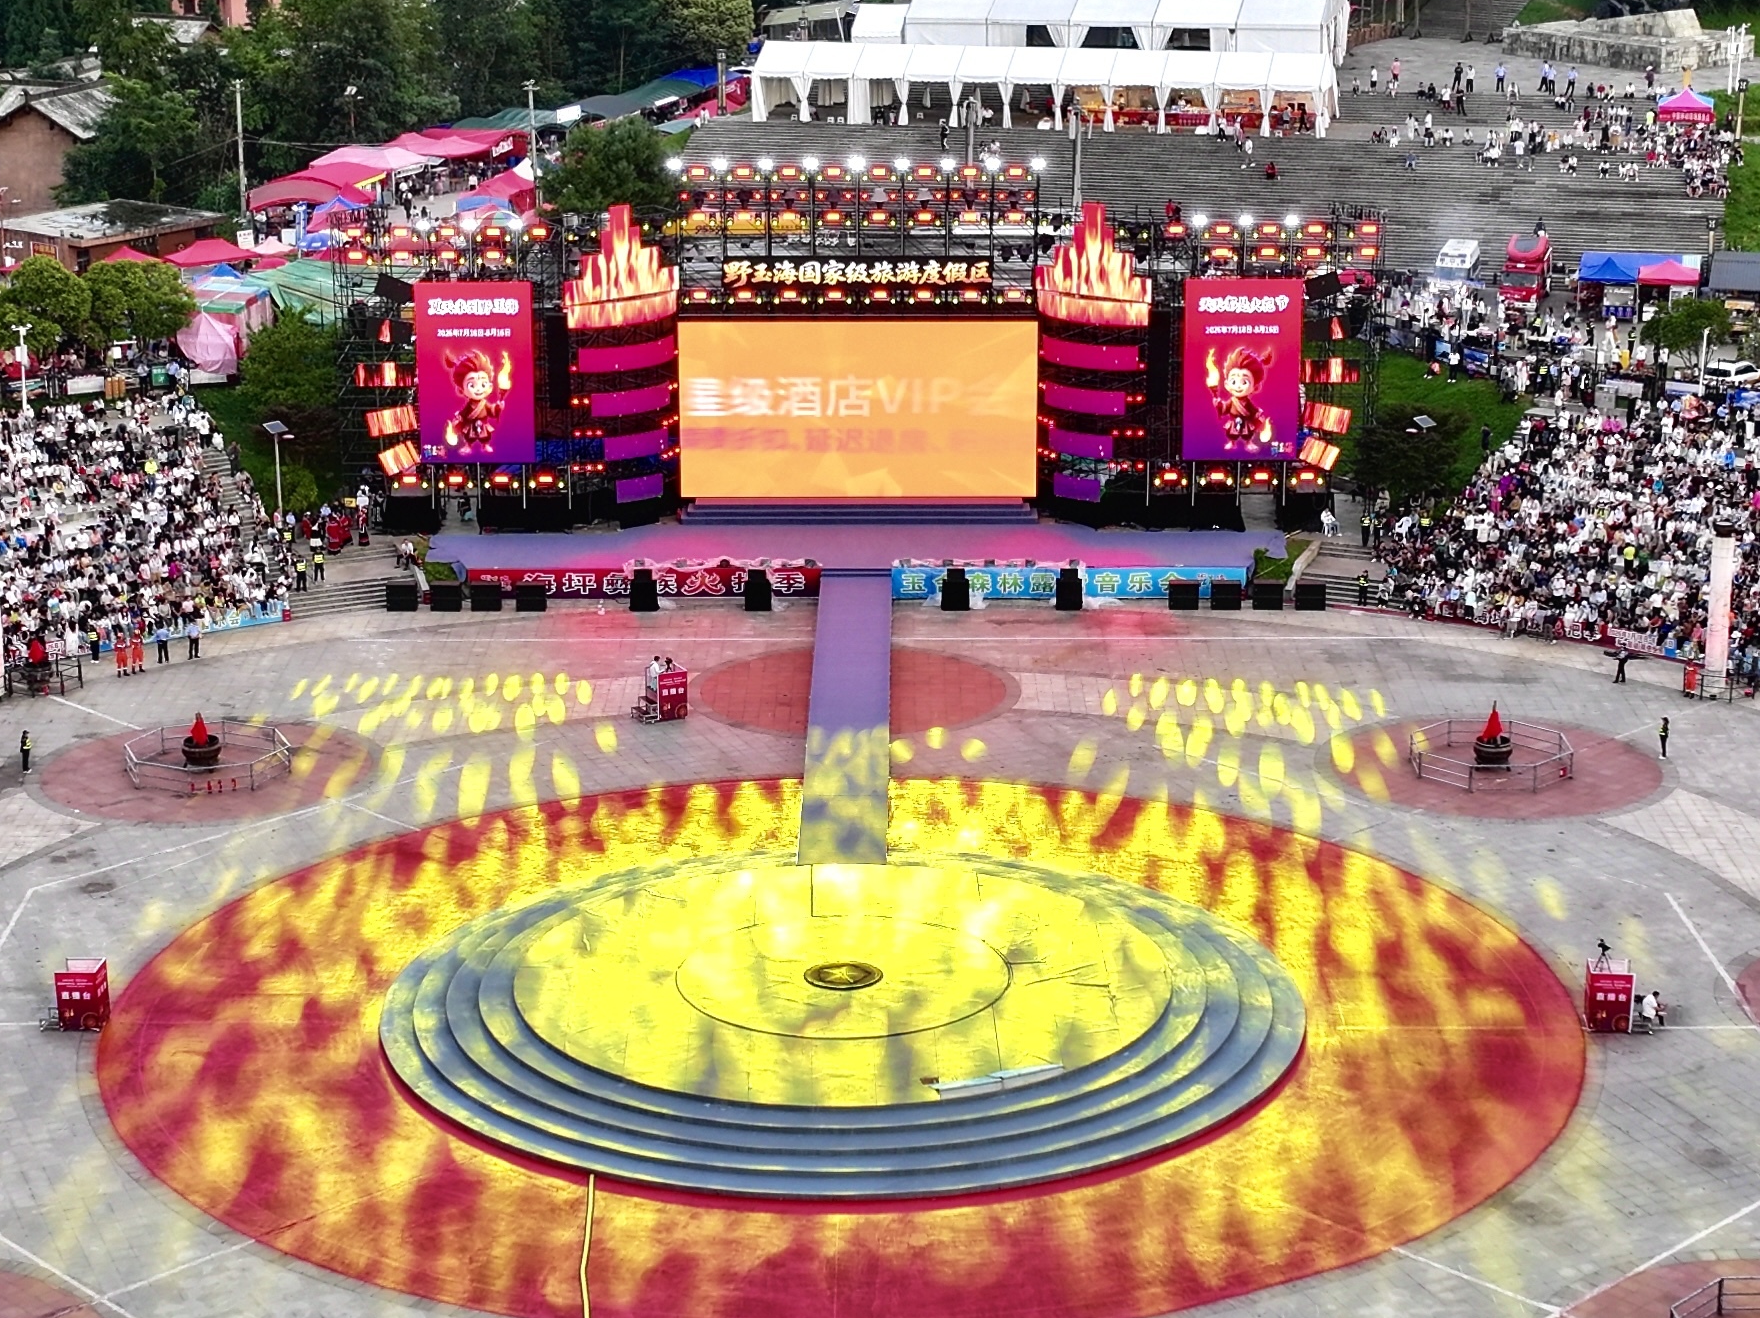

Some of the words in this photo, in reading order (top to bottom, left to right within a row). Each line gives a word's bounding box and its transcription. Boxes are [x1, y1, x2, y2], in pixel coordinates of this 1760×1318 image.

[723, 259, 993, 288] 野玉海国家级旅游度假区
